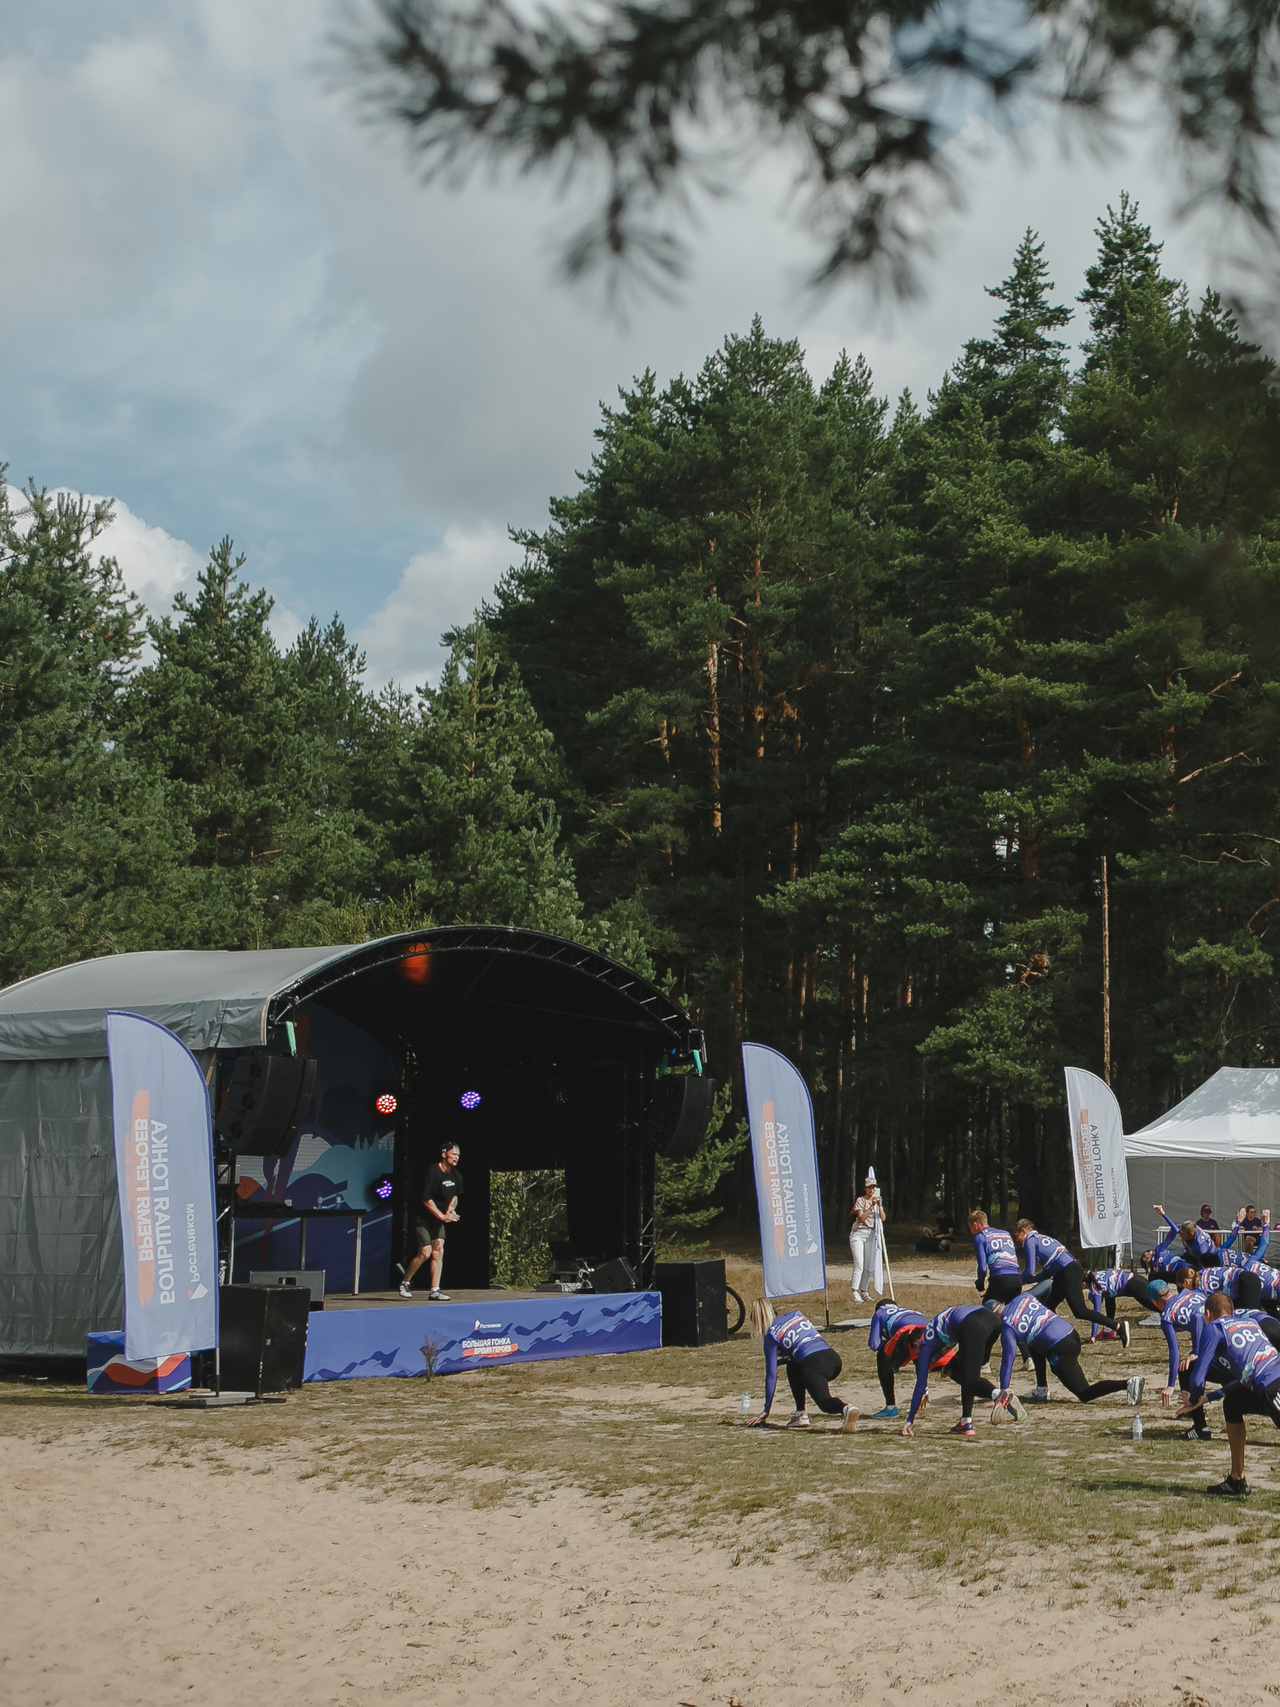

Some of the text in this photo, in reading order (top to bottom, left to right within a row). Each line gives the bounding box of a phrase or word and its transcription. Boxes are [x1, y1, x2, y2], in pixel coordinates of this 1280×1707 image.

[782, 1319, 813, 1349] 02-0
[462, 1338, 511, 1348] БОЛЬШАЯ ГОНКА
[492, 1345, 512, 1353] ГЕРОЕВ
